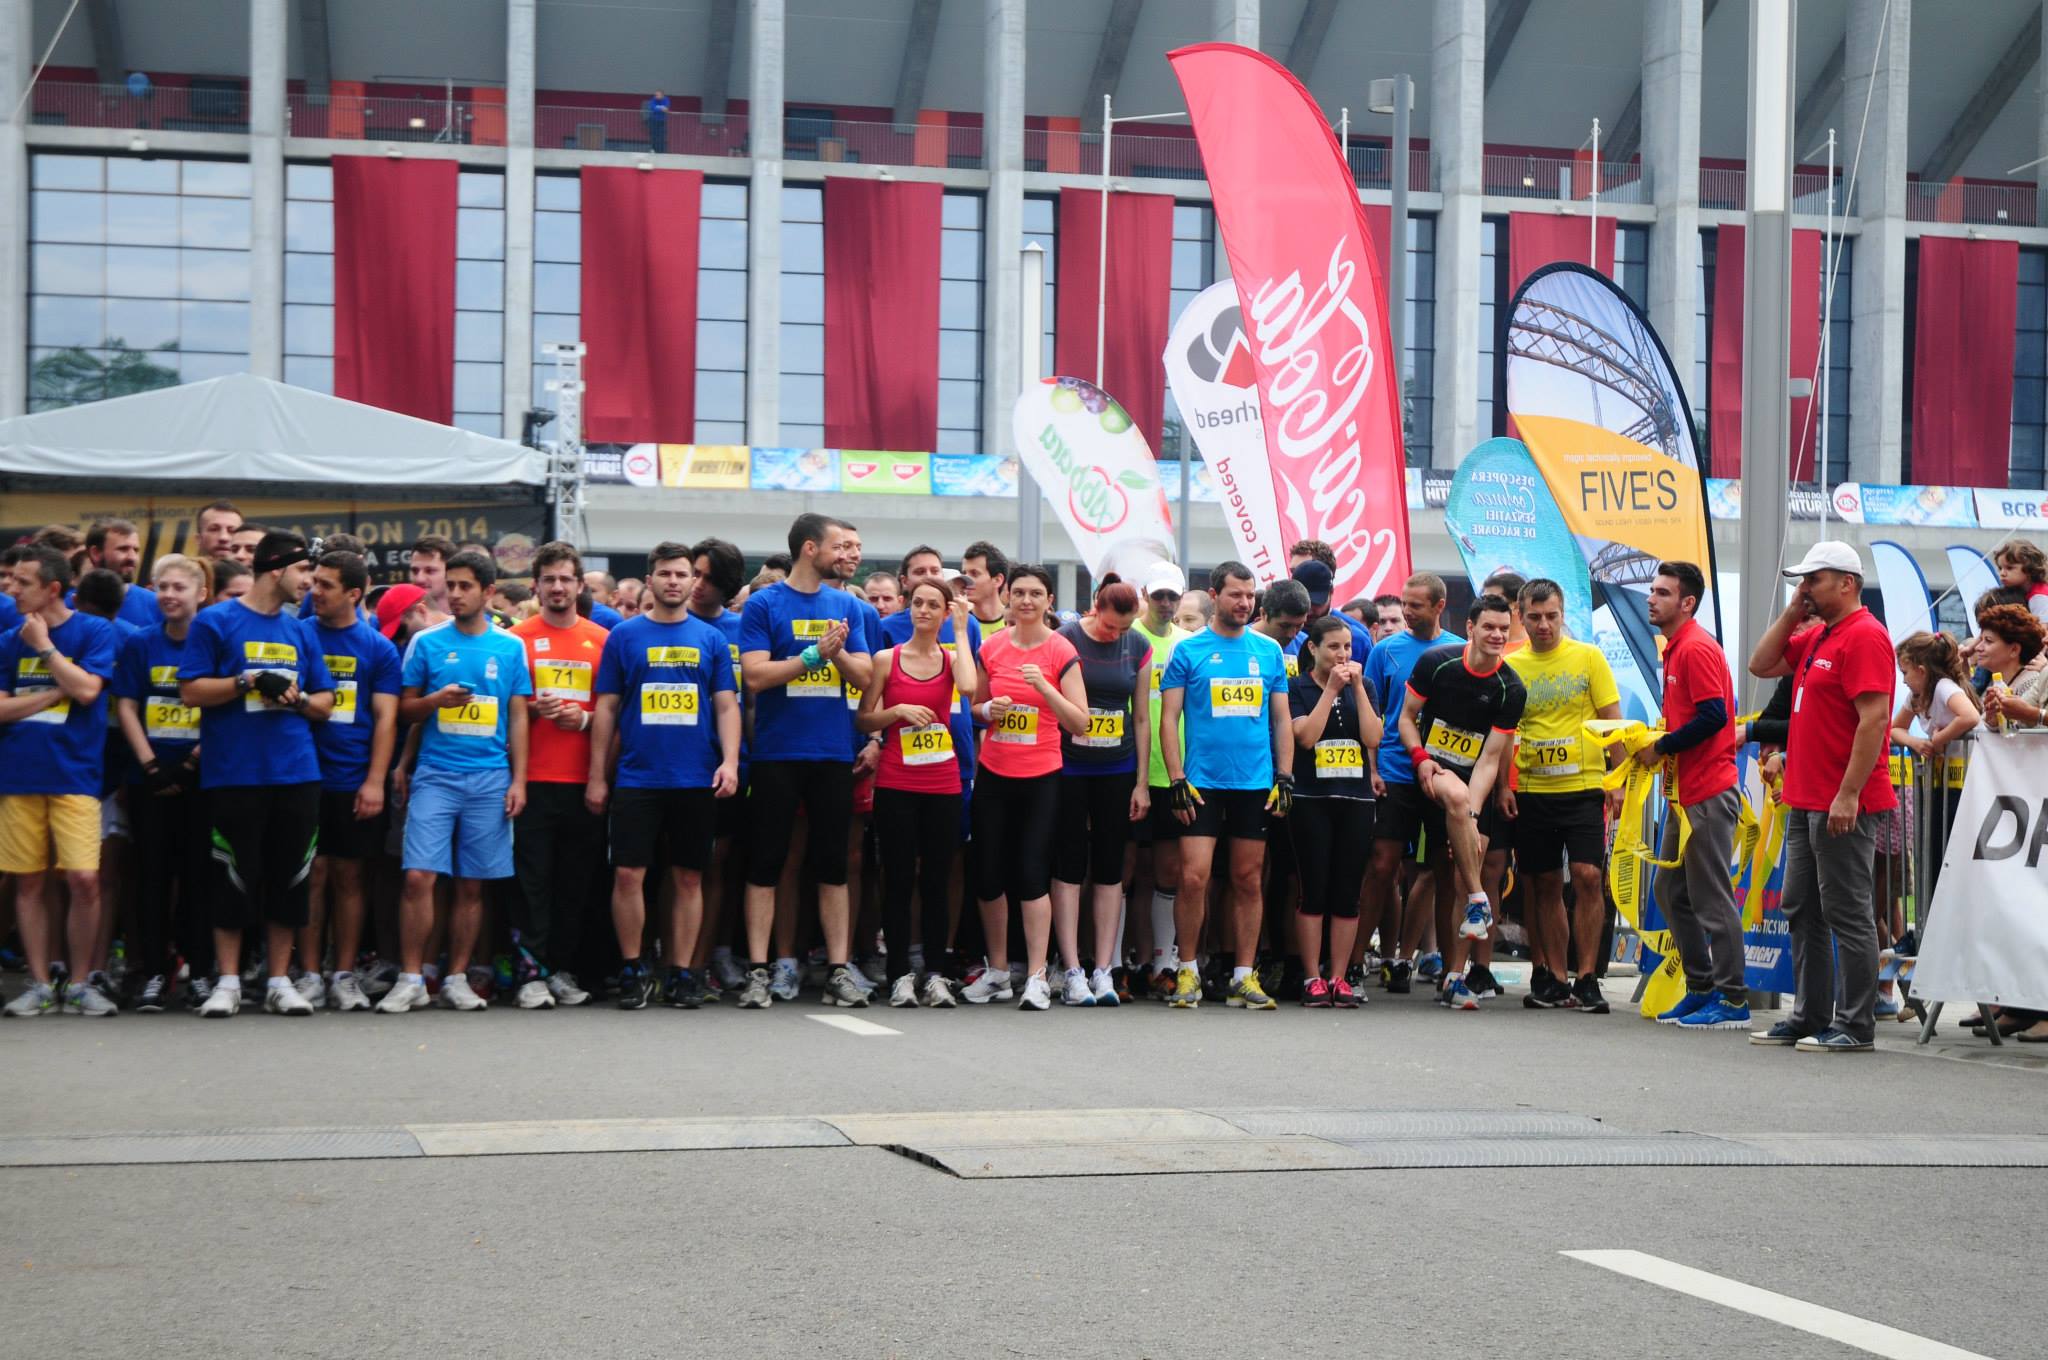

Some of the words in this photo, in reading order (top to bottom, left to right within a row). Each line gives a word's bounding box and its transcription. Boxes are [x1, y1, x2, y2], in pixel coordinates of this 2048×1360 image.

[1580, 469, 1677, 511] FIVE'S
[2002, 502, 2037, 518] BCR
[416, 517, 488, 542] 2014
[552, 669, 572, 686] 71
[648, 692, 694, 710] 1033
[1221, 686, 1255, 702] 649
[157, 706, 192, 723] 301
[457, 704, 480, 721] 70
[912, 732, 943, 750] 487
[1438, 730, 1471, 753] 370
[1326, 748, 1356, 764] 373
[1536, 746, 1568, 764] 179
